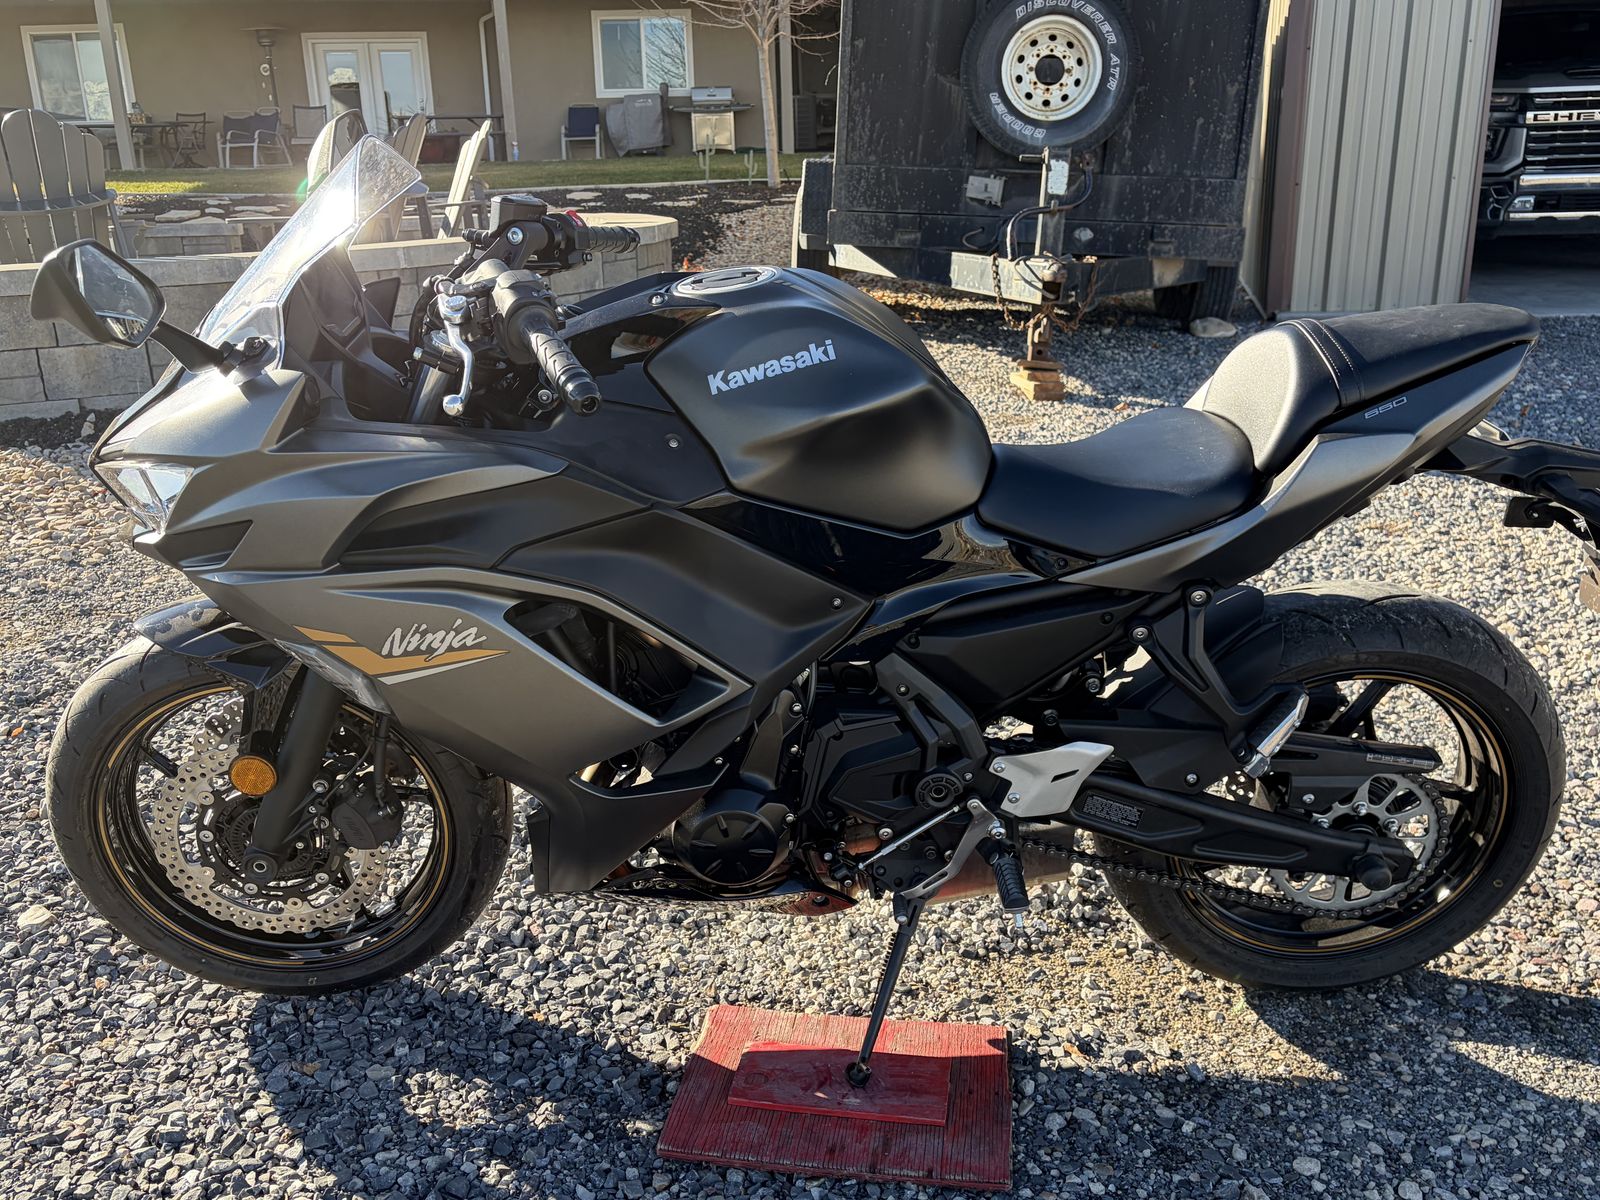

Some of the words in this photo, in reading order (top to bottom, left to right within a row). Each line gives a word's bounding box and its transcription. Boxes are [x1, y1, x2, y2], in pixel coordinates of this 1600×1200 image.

[1106, 53, 1121, 91] ATR
[989, 92, 1047, 138] COOPER
[1532, 111, 1600, 122] CHE
[707, 339, 837, 396] Kawasaki
[1364, 396, 1408, 419] 650
[381, 618, 487, 662] Ninja
